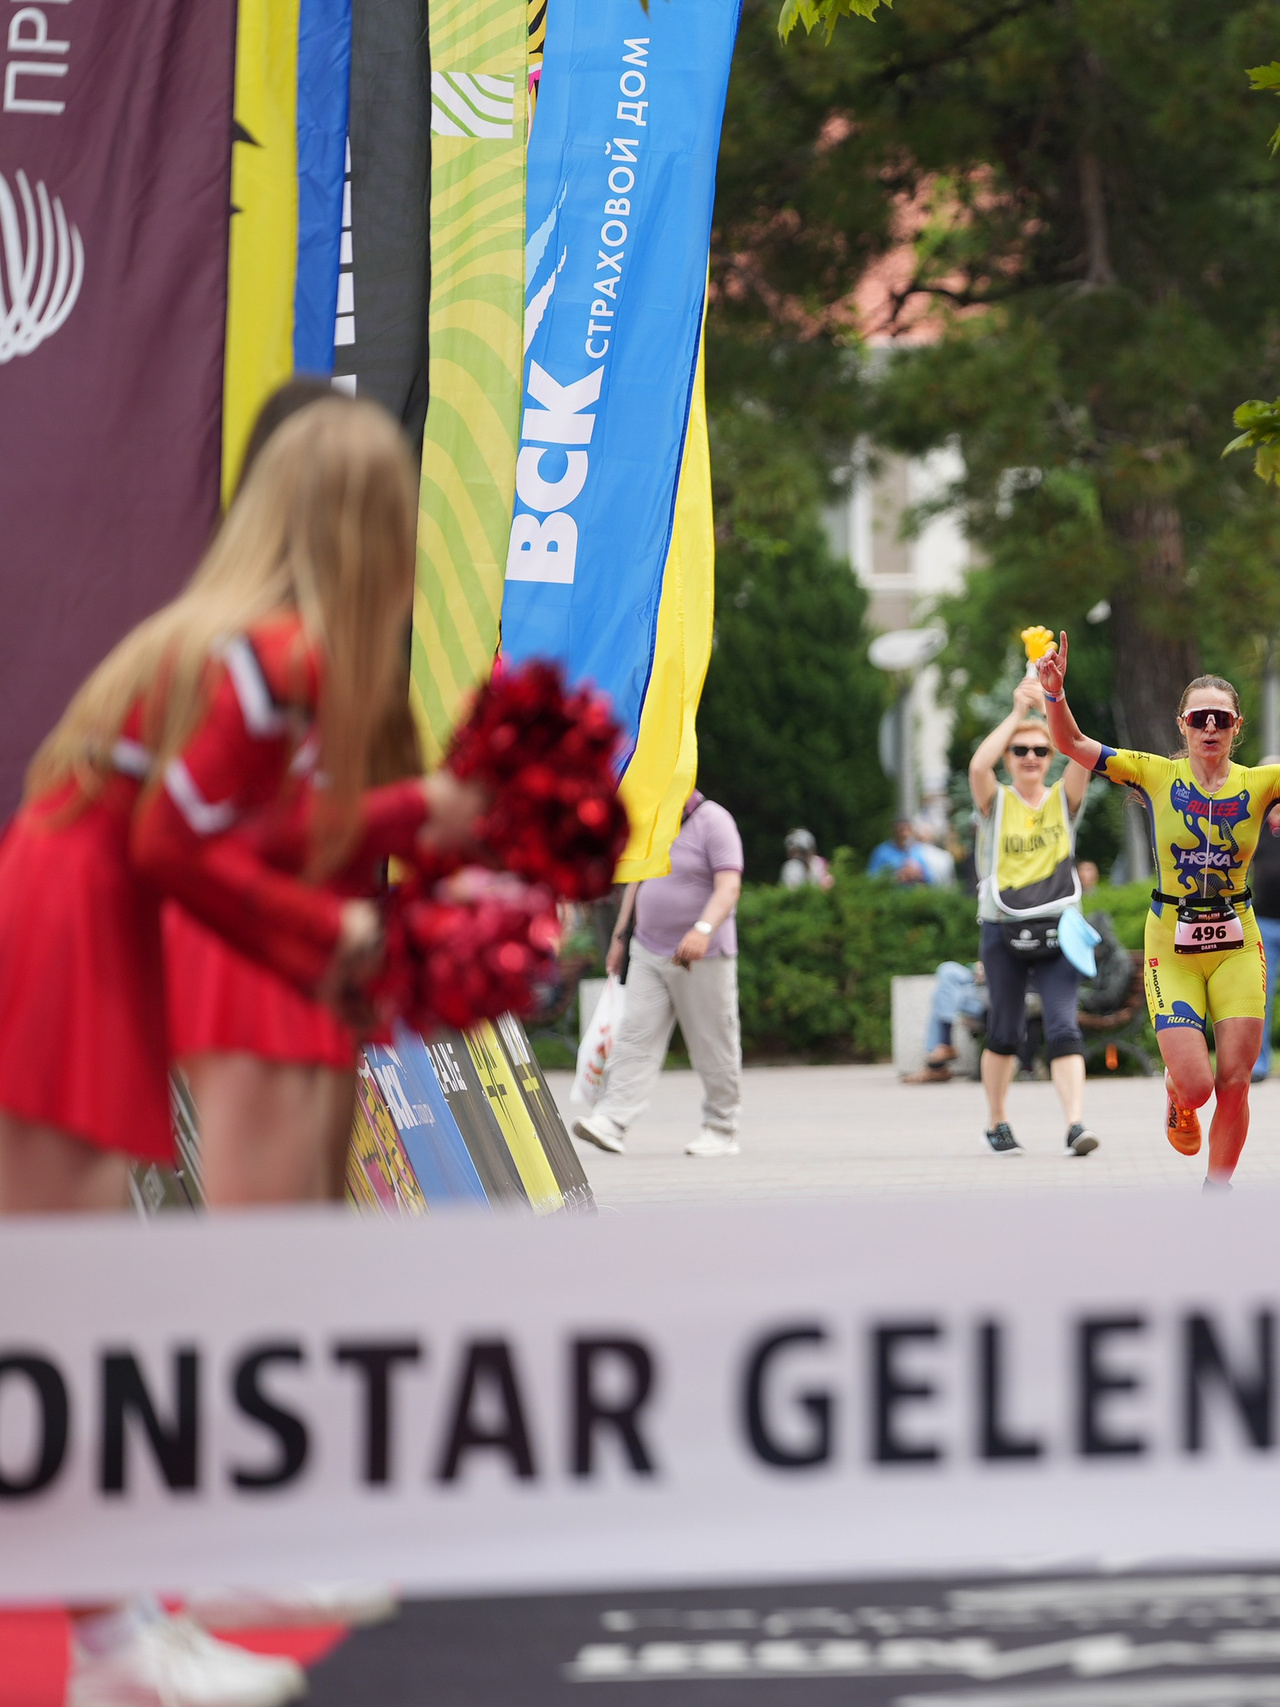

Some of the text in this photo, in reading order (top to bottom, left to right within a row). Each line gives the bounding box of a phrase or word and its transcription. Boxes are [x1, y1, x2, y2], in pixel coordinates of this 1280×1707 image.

[3, 0, 72, 115] ПР
[585, 37, 650, 359] СТРАХОВОЙ ДОМ
[505, 359, 605, 584] ВСК
[1180, 851, 1232, 867] HOKA
[1152, 969, 1164, 1009] ARGON 18
[1192, 925, 1226, 941] 496
[0, 1328, 660, 1500] ONSTAR
